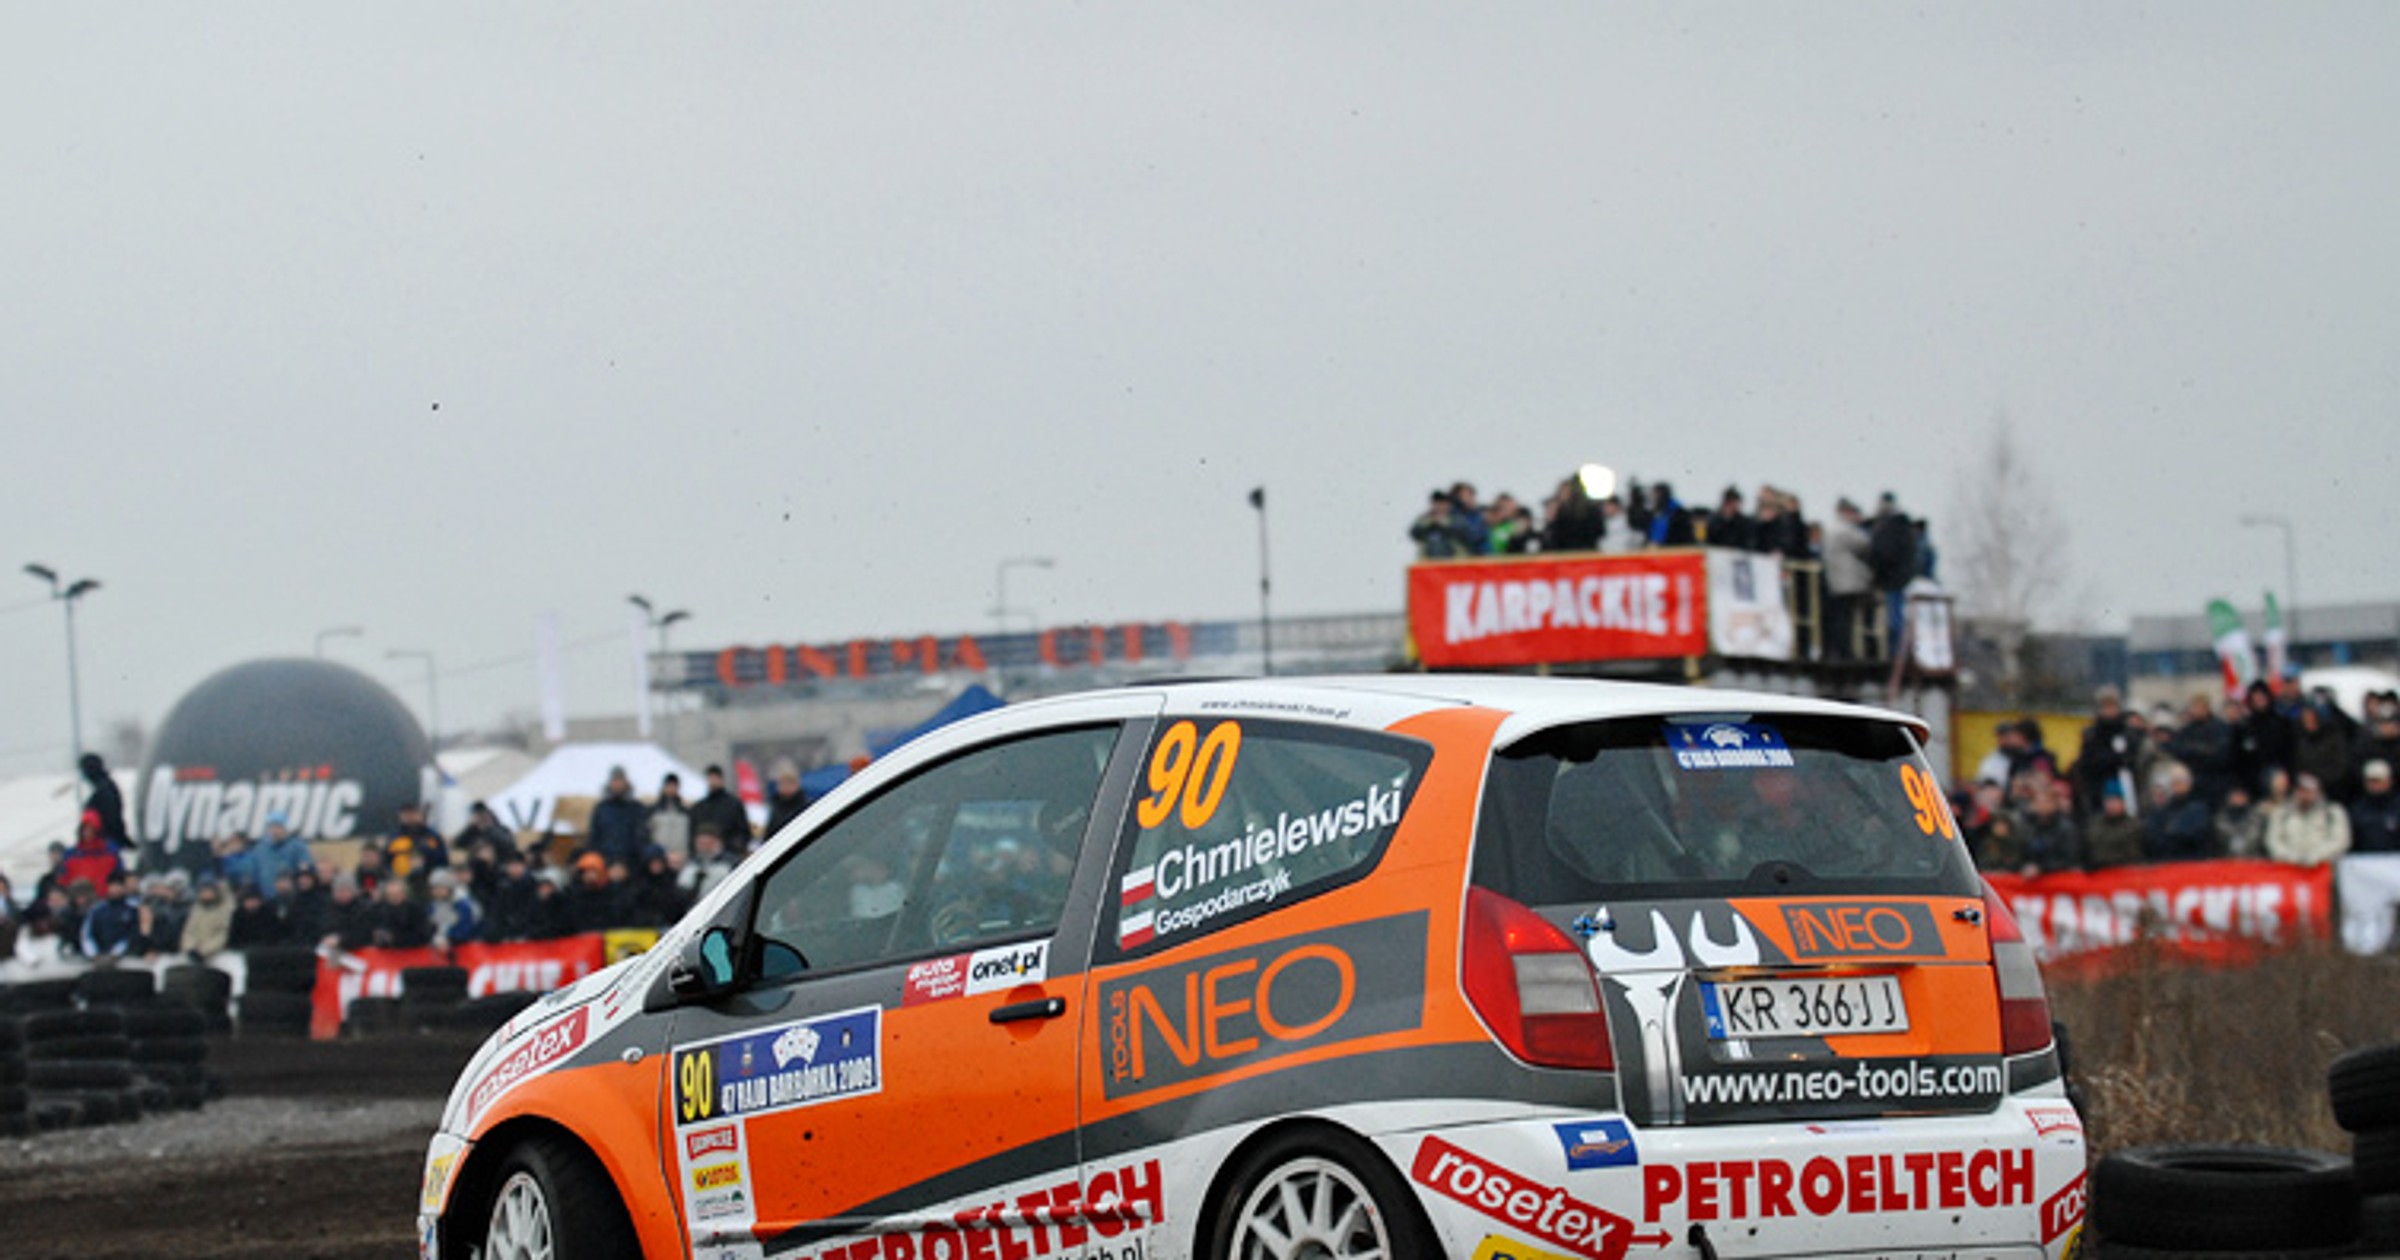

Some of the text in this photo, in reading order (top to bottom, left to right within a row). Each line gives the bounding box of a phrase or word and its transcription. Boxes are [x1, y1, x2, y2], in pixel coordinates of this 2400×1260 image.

[1445, 574, 1668, 644] KARPACKIE
[716, 621, 1192, 688] CINEMA CITY
[1137, 719, 1241, 829] 90
[1900, 763, 1953, 839] 90
[1157, 778, 1400, 898] Chmielewski
[1156, 869, 1292, 934] Gospodarczyk
[1799, 907, 1913, 952] NEO
[972, 945, 1043, 980] onet.pl
[1111, 990, 1129, 1084] TOOLS
[1128, 943, 1356, 1080] NEO
[1723, 986, 1779, 1032] KR
[680, 1050, 712, 1121] 90
[1682, 1059, 2001, 1102] www.neo-tools.com
[1428, 1151, 1616, 1254] rosetex
[1643, 1148, 2035, 1223] PETROELTECH
